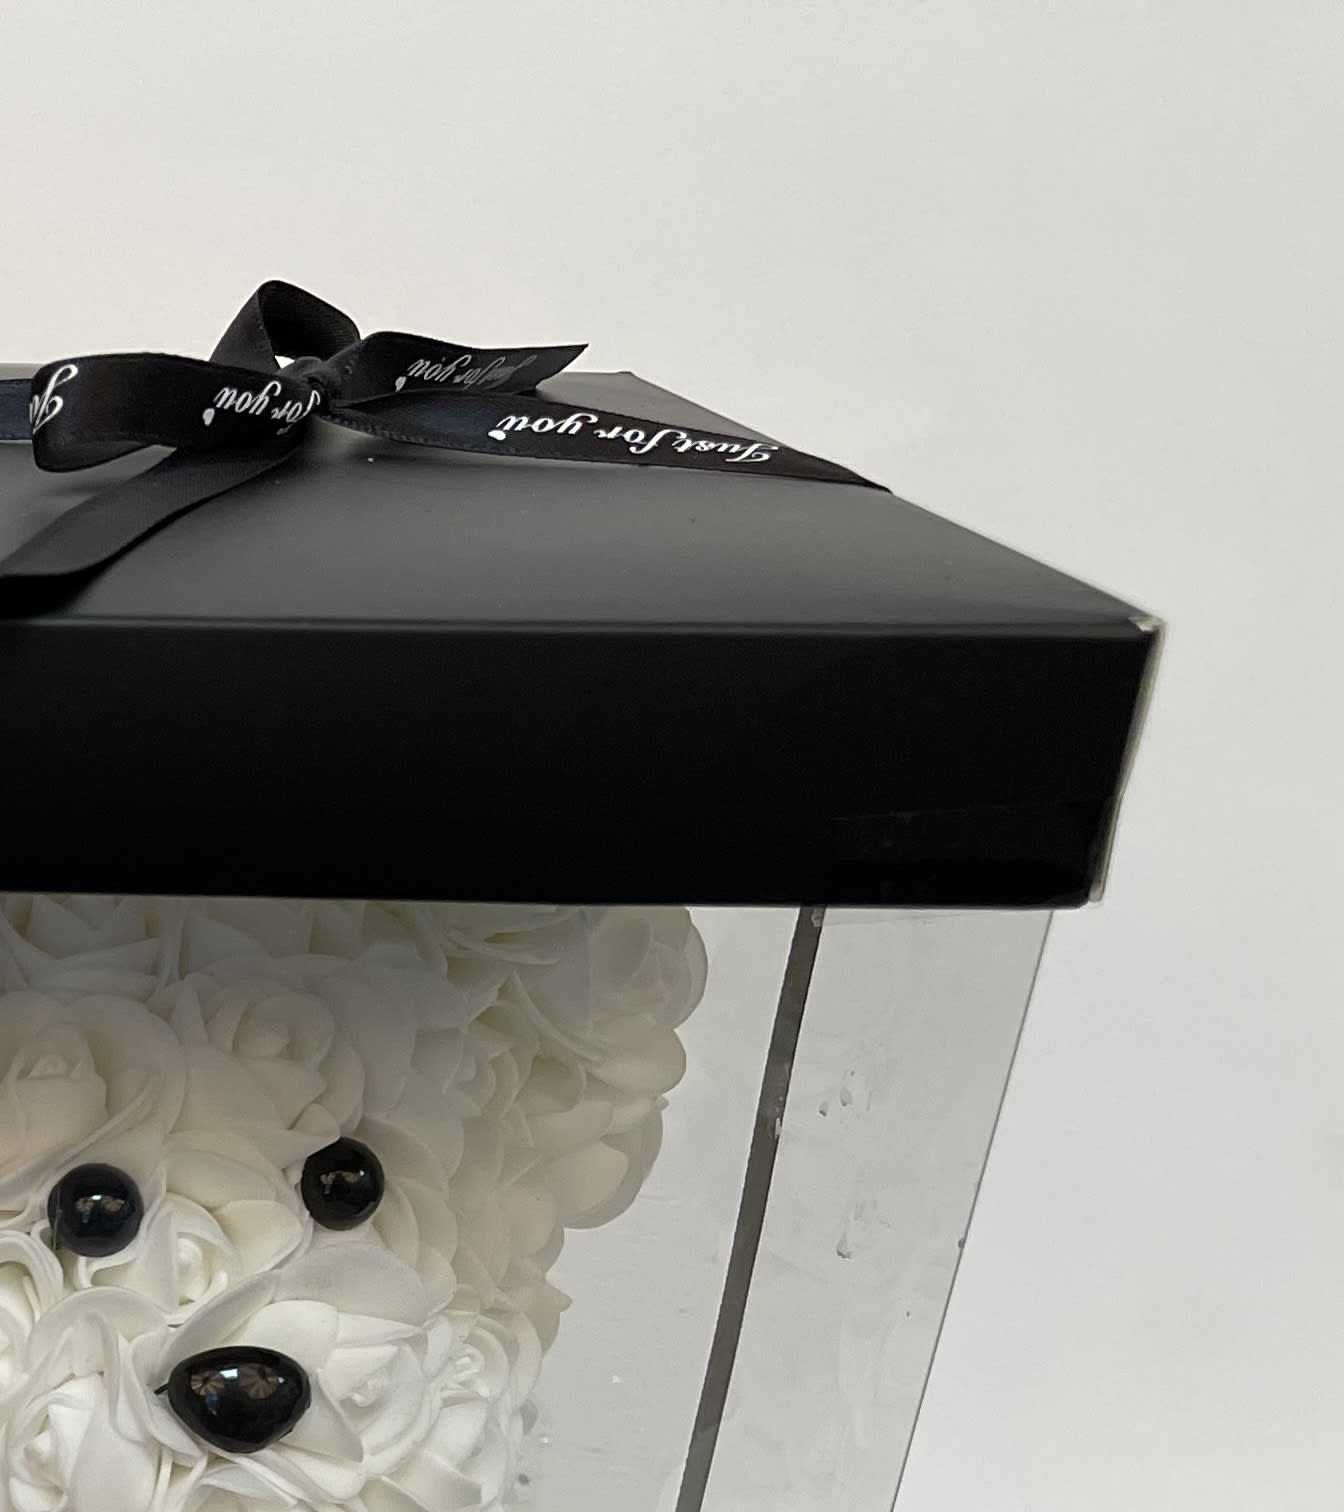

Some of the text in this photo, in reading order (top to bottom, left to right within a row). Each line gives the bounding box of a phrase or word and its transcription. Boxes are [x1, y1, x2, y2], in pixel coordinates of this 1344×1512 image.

[214, 380, 282, 416] you
[496, 412, 779, 463] Just for you
